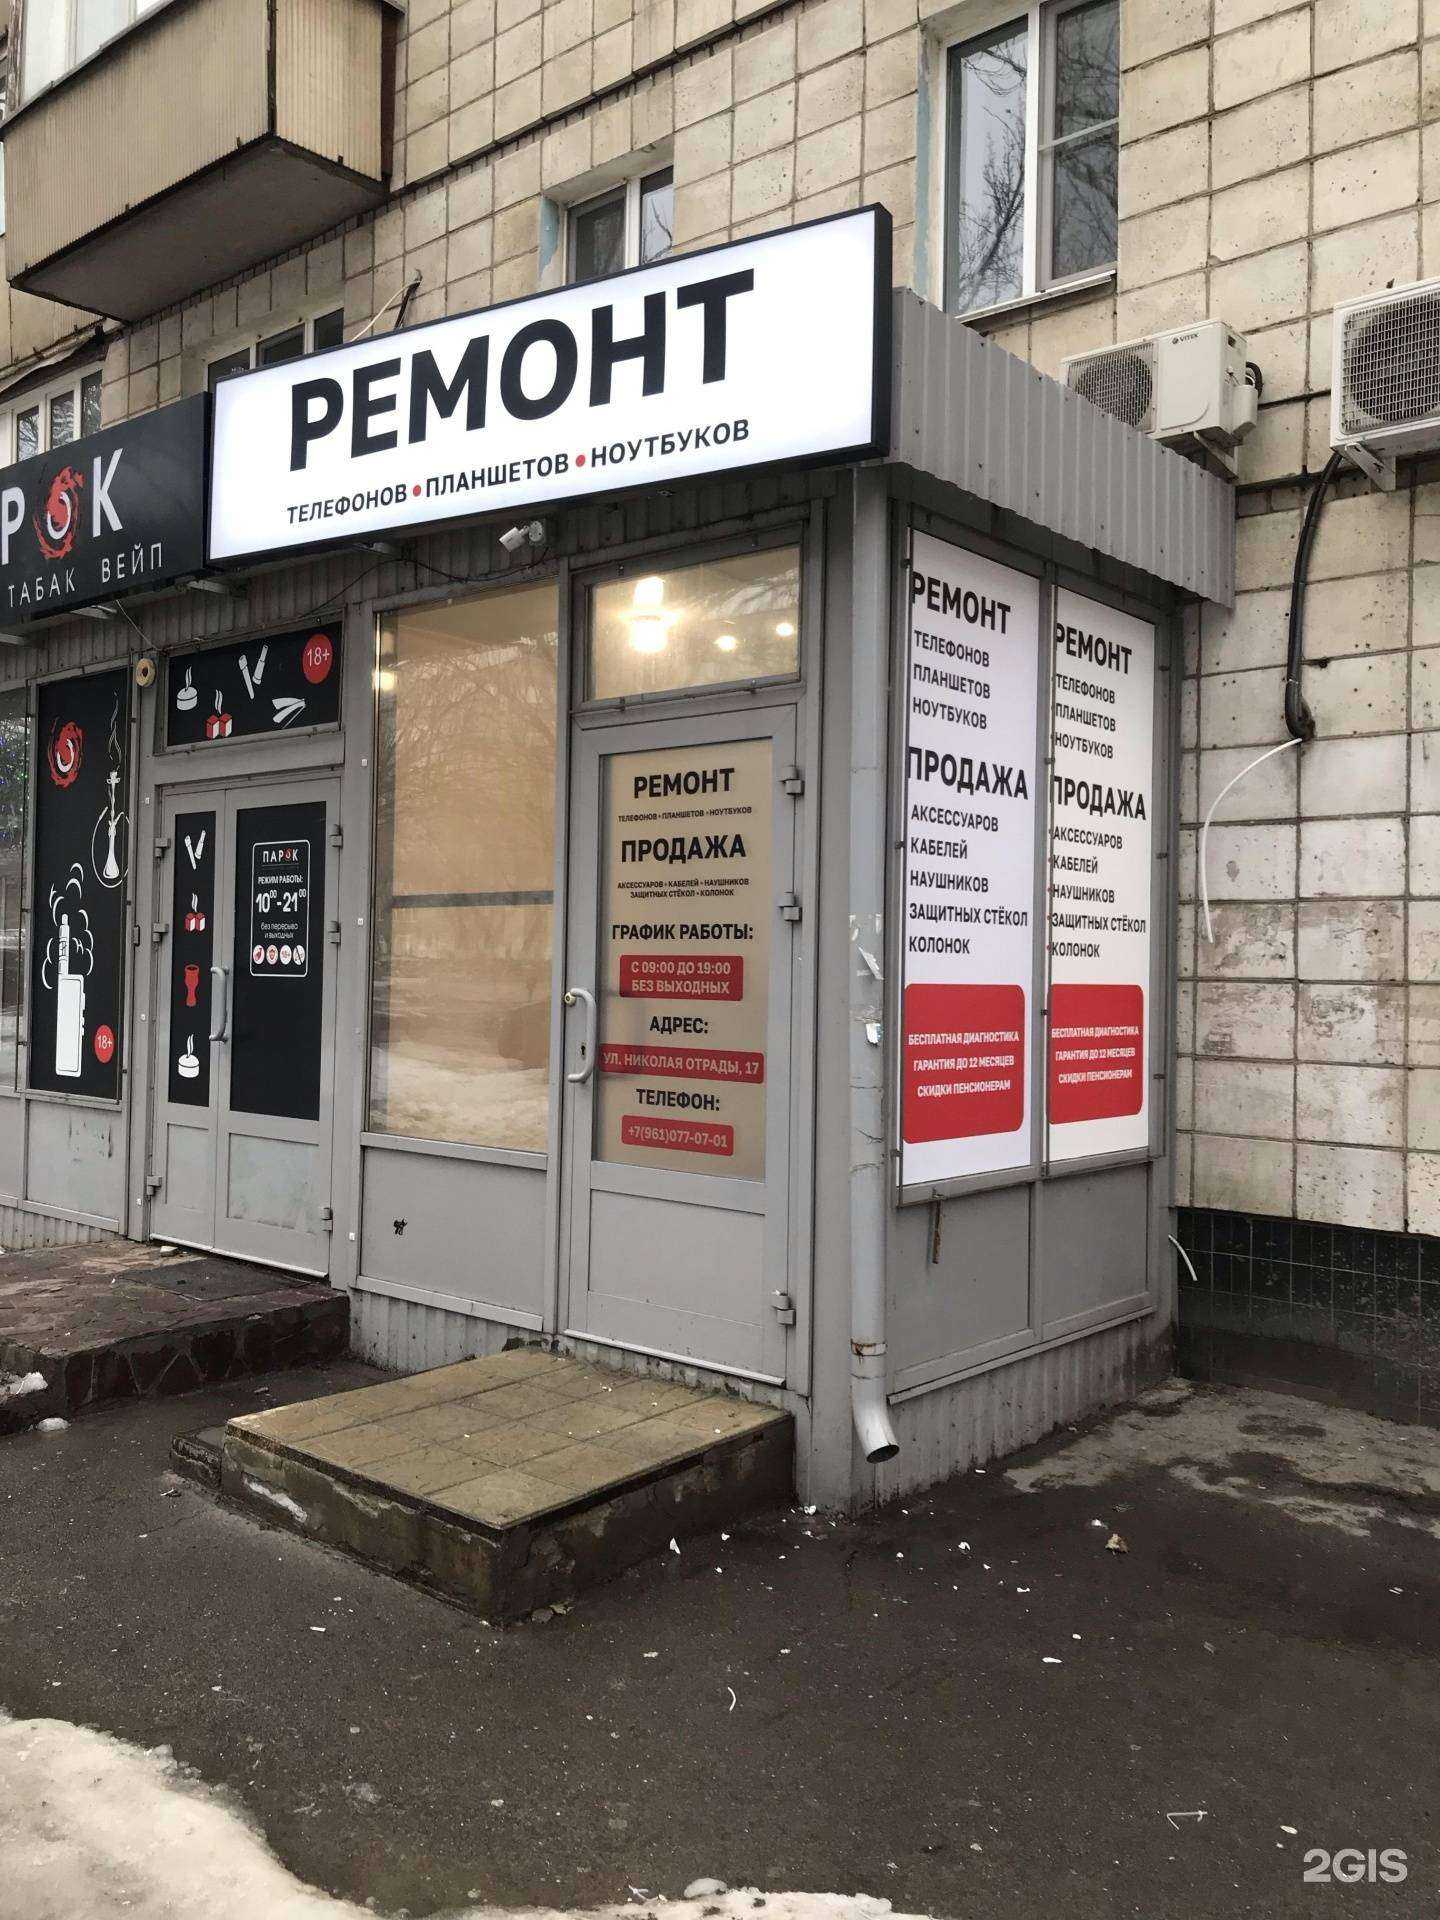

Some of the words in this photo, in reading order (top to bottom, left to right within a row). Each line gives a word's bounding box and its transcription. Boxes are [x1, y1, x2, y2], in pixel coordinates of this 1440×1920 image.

[290, 268, 754, 471] РЕМОНТ
[287, 484, 407, 524] ТЕЛЕФОНОВ
[426, 453, 569, 497] ПЛАНШЕТОВ
[591, 419, 749, 468] НОУТБУКОВ
[8, 567, 75, 608] ТАБАК
[101, 542, 162, 583] ВЕЙП
[911, 571, 1011, 634] РЕМОНТ
[306, 648, 330, 668] 18+
[914, 629, 990, 668] ТЕЛЕФОНОВ
[913, 663, 991, 699] ПЛАНШЕТОВ
[1056, 673, 1115, 704] ТЕЛЕФОНОВ
[912, 697, 987, 730] НОУТБУКОВ
[1055, 702, 1116, 732] ПЛАНШЕТОВ
[1054, 731, 1114, 759] НОУТБУКОВ
[634, 768, 735, 799] РЕМОНТ
[907, 746, 1029, 801] ПРОДАЖА
[1053, 774, 1146, 820] ПРОДАЖА
[618, 813, 658, 822] ТЕЛЕФОНОВ
[661, 810, 704, 820] ПЛАНШЕТОВ
[709, 806, 752, 816] НОУТБУКОВ
[911, 804, 999, 832] АКСЕССУАРОВ
[910, 837, 968, 859] КАБЕЛЕЙ
[1053, 826, 1123, 850] АКСЕССУАРОВ
[262, 849, 299, 863] ПАРОК
[621, 834, 746, 864] ПРОДАЖА
[1053, 854, 1099, 874] КАБЕЛЕЙ
[258, 876, 278, 884] РЕЖИМ
[279, 874, 304, 883] РАБОТЫ:
[617, 880, 664, 889] АКСЕССУАРОВ
[668, 878, 699, 888] КАБЕЛЕЙ
[704, 878, 749, 886] НАУШНИКОВ
[910, 870, 989, 893] НАУШНИКОВ
[630, 890, 668, 899] ЗАЩИТНЫХ
[668, 889, 695, 898] СТЁКОЛ
[700, 889, 734, 897] КОЛОНОК
[1052, 884, 1115, 903] НАУШНИКОВ
[909, 902, 981, 924] ЗАЩИТНЫХ
[983, 906, 1028, 926] СТЁКОЛ
[1052, 912, 1109, 931] ЗАЩИТНЫХ
[1110, 915, 1146, 933] СТЁКОЛ
[612, 924, 676, 940] ГРАФИК
[679, 923, 753, 940] РАБОТЫ:
[908, 936, 970, 954] КОЛОНОК
[1052, 941, 1100, 958] КОЛОНОК
[631, 962, 639, 972] С
[641, 962, 674, 972] 09:00
[676, 962, 695, 975] ДО
[697, 962, 731, 975] 19:00
[631, 980, 653, 992] БЕЗ
[656, 980, 730, 995] ВЫХОДНЫХ
[650, 1016, 709, 1034] АДРЕС:
[1051, 1028, 1095, 1038] БЕСПЛАТНАЯ
[1094, 1026, 1139, 1037] ДИАГНОСТИКА
[96, 1035, 113, 1050] 18+
[908, 1033, 963, 1045] БЕСПЛАТНАЯ
[963, 1031, 1020, 1045] ДИАГНОСТИКА
[603, 1053, 622, 1065] УЛ.
[624, 1054, 683, 1069] НИКОЛАЯ
[685, 1058, 743, 1075] ОТРАДЫ,
[745, 1062, 760, 1074] 17
[913, 1059, 955, 1071] ГАРАНТИЯ
[956, 1058, 968, 1071] ДО
[968, 1057, 978, 1069] 12
[978, 1055, 1015, 1068] МЕСЯЦЕВ
[1055, 1051, 1089, 1061] ГАРАНТИЯ
[1089, 1050, 1099, 1061] ДО
[1099, 1049, 1106, 1059] 12
[1106, 1047, 1136, 1059] МЕСЯЦЕВ
[1058, 1073, 1086, 1084] СКИДКИ
[1086, 1068, 1133, 1081] ПЕНСИОНЕРАМ
[636, 1088, 720, 1111] ТЕЛЕФОН:
[917, 1084, 952, 1098] СКИДКИ
[953, 1080, 1011, 1094] ПЕНСИОНЕРАМ
[628, 1125, 728, 1148] +7(961)077-07-01
